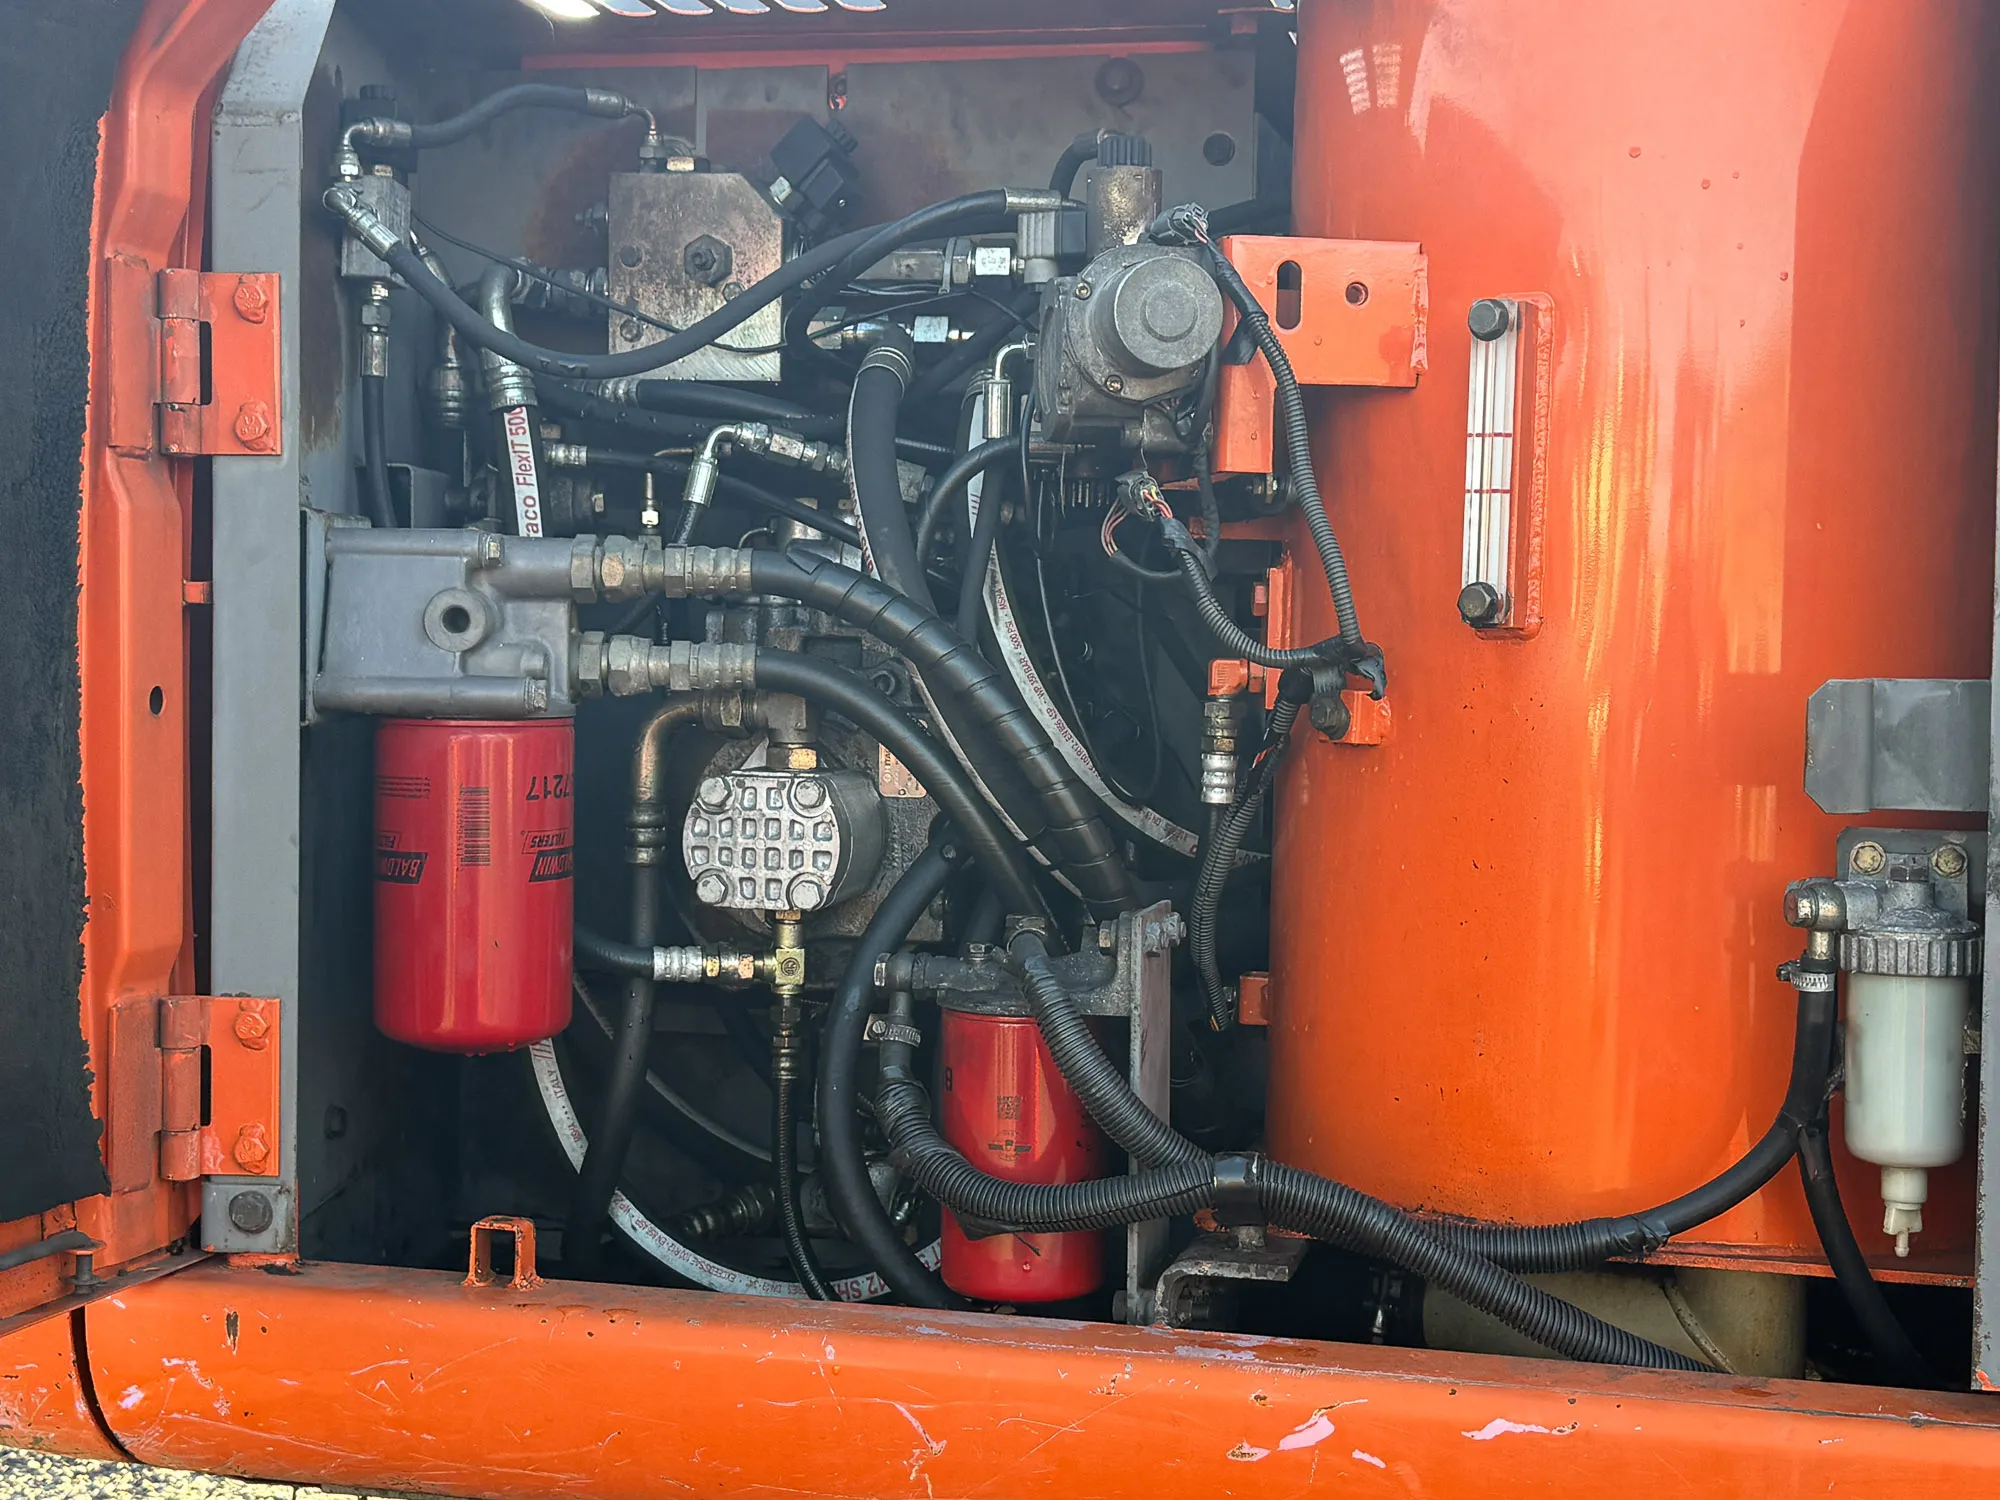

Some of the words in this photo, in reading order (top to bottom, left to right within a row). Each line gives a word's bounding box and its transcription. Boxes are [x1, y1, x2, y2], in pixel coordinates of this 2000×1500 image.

[511, 440, 535, 486] FlexIT
[523, 495, 540, 537] aco
[1004, 621, 1015, 633] PSI
[1019, 656, 1032, 673] BAR
[526, 774, 573, 800] 7217
[530, 831, 567, 848] FILTERS
[547, 1069, 565, 1099] ITALY
